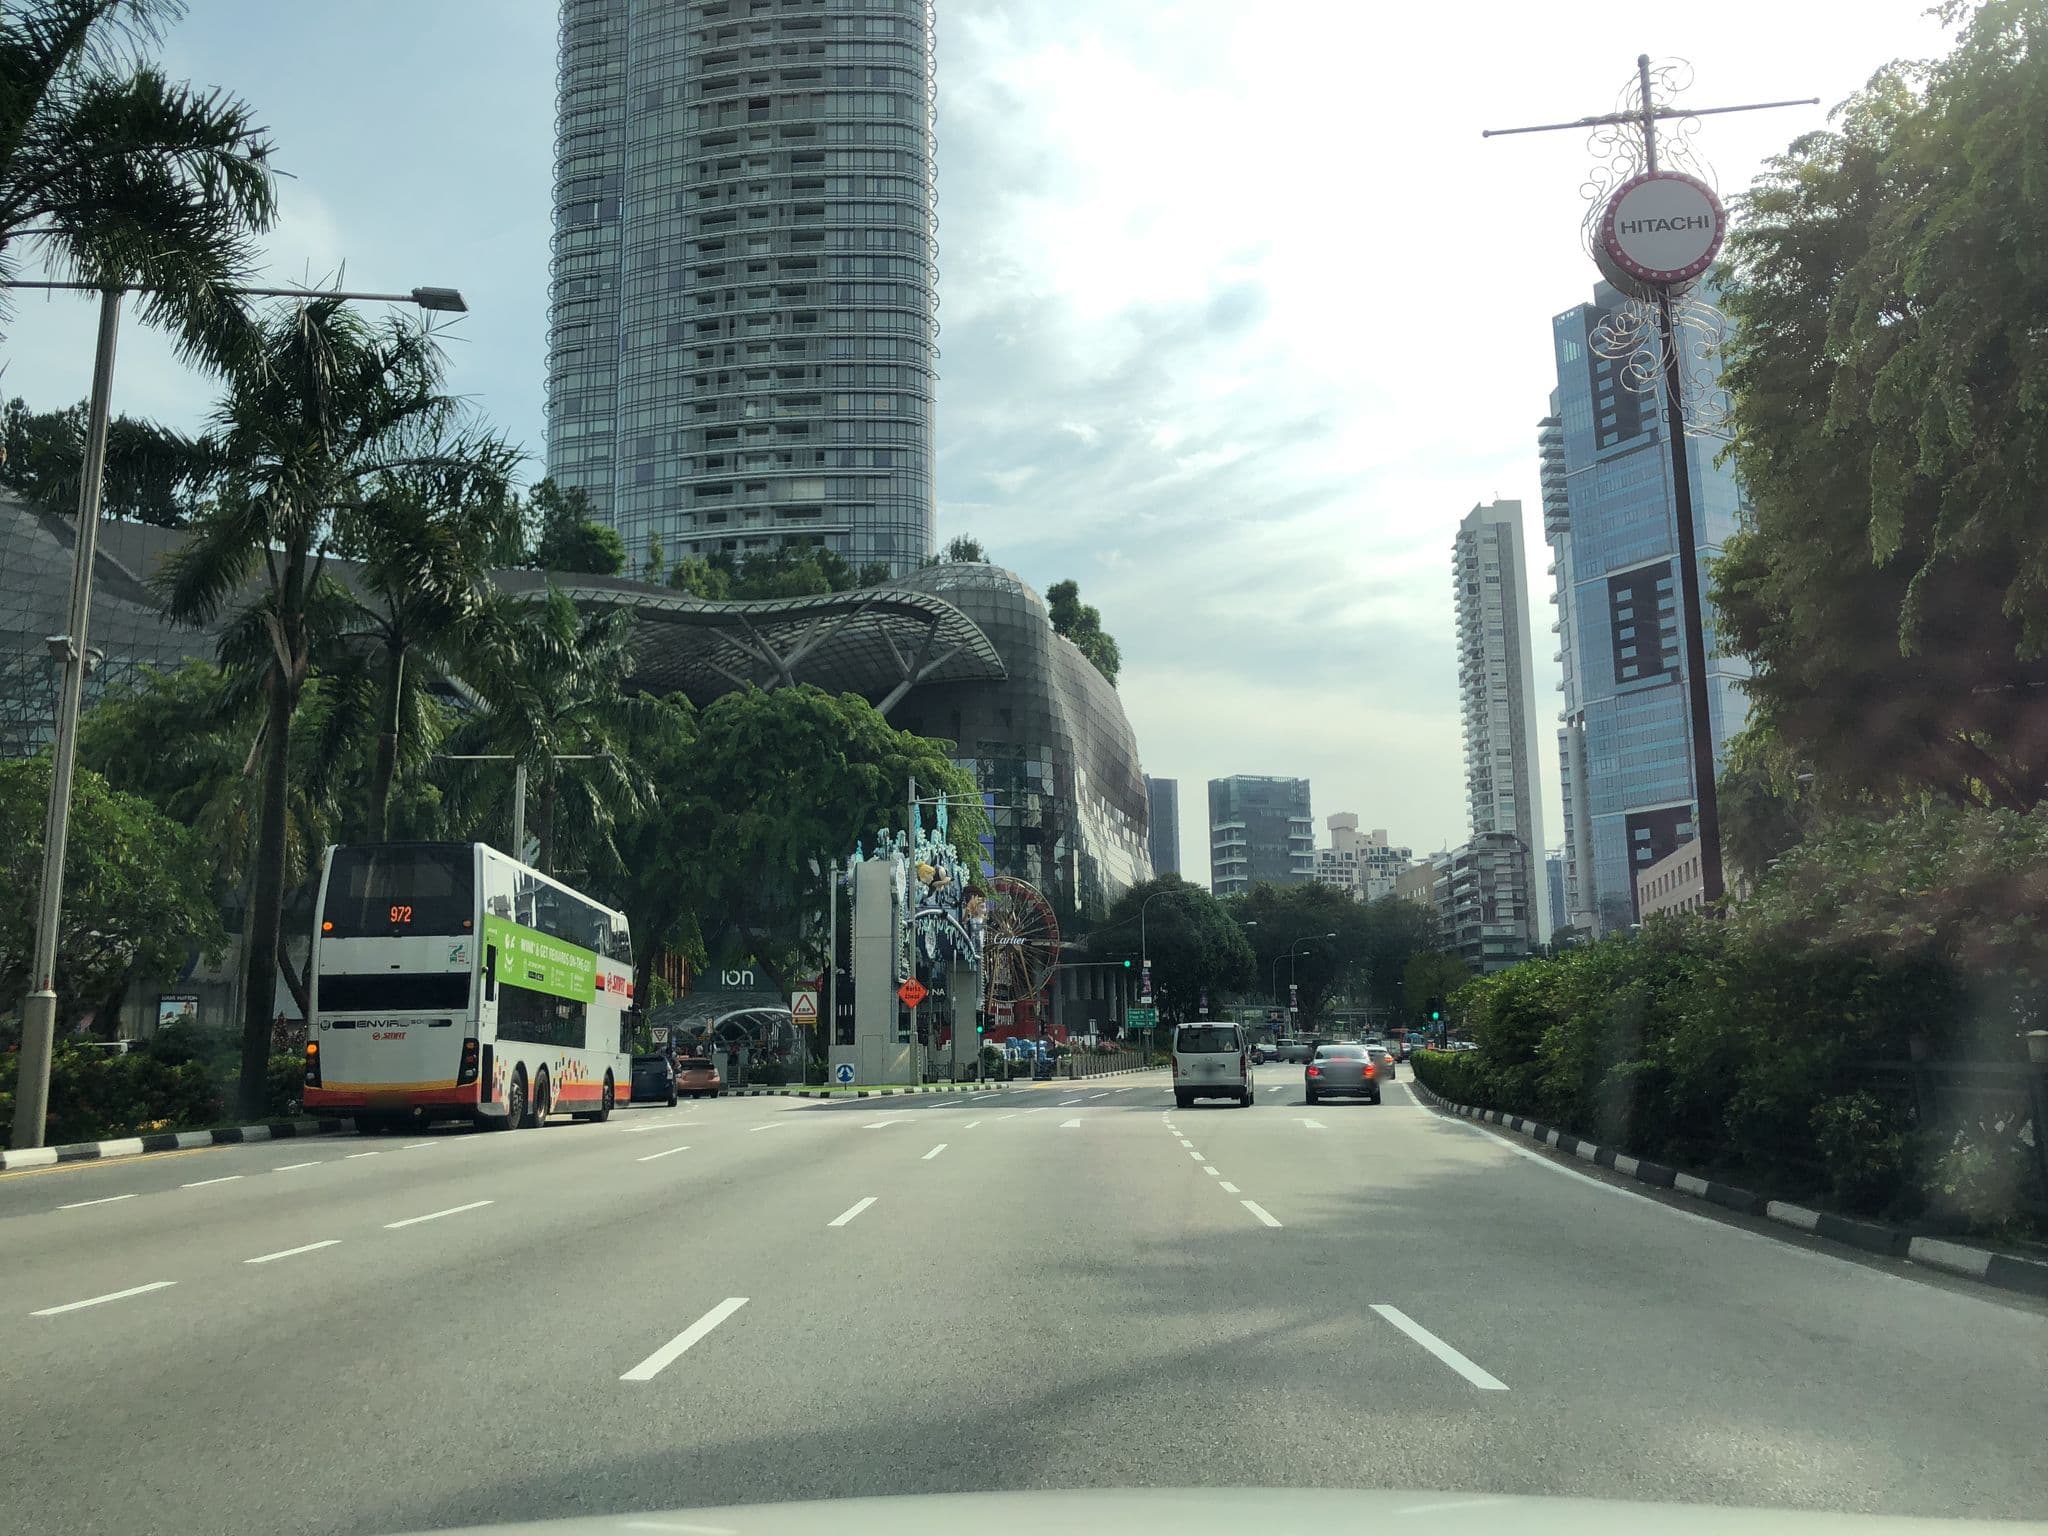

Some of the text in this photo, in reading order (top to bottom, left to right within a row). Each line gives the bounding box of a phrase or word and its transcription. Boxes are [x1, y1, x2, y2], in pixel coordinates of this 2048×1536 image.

[1621, 215, 1710, 235] HITACHI
[390, 906, 412, 923] 972
[994, 932, 1027, 944] Cartier
